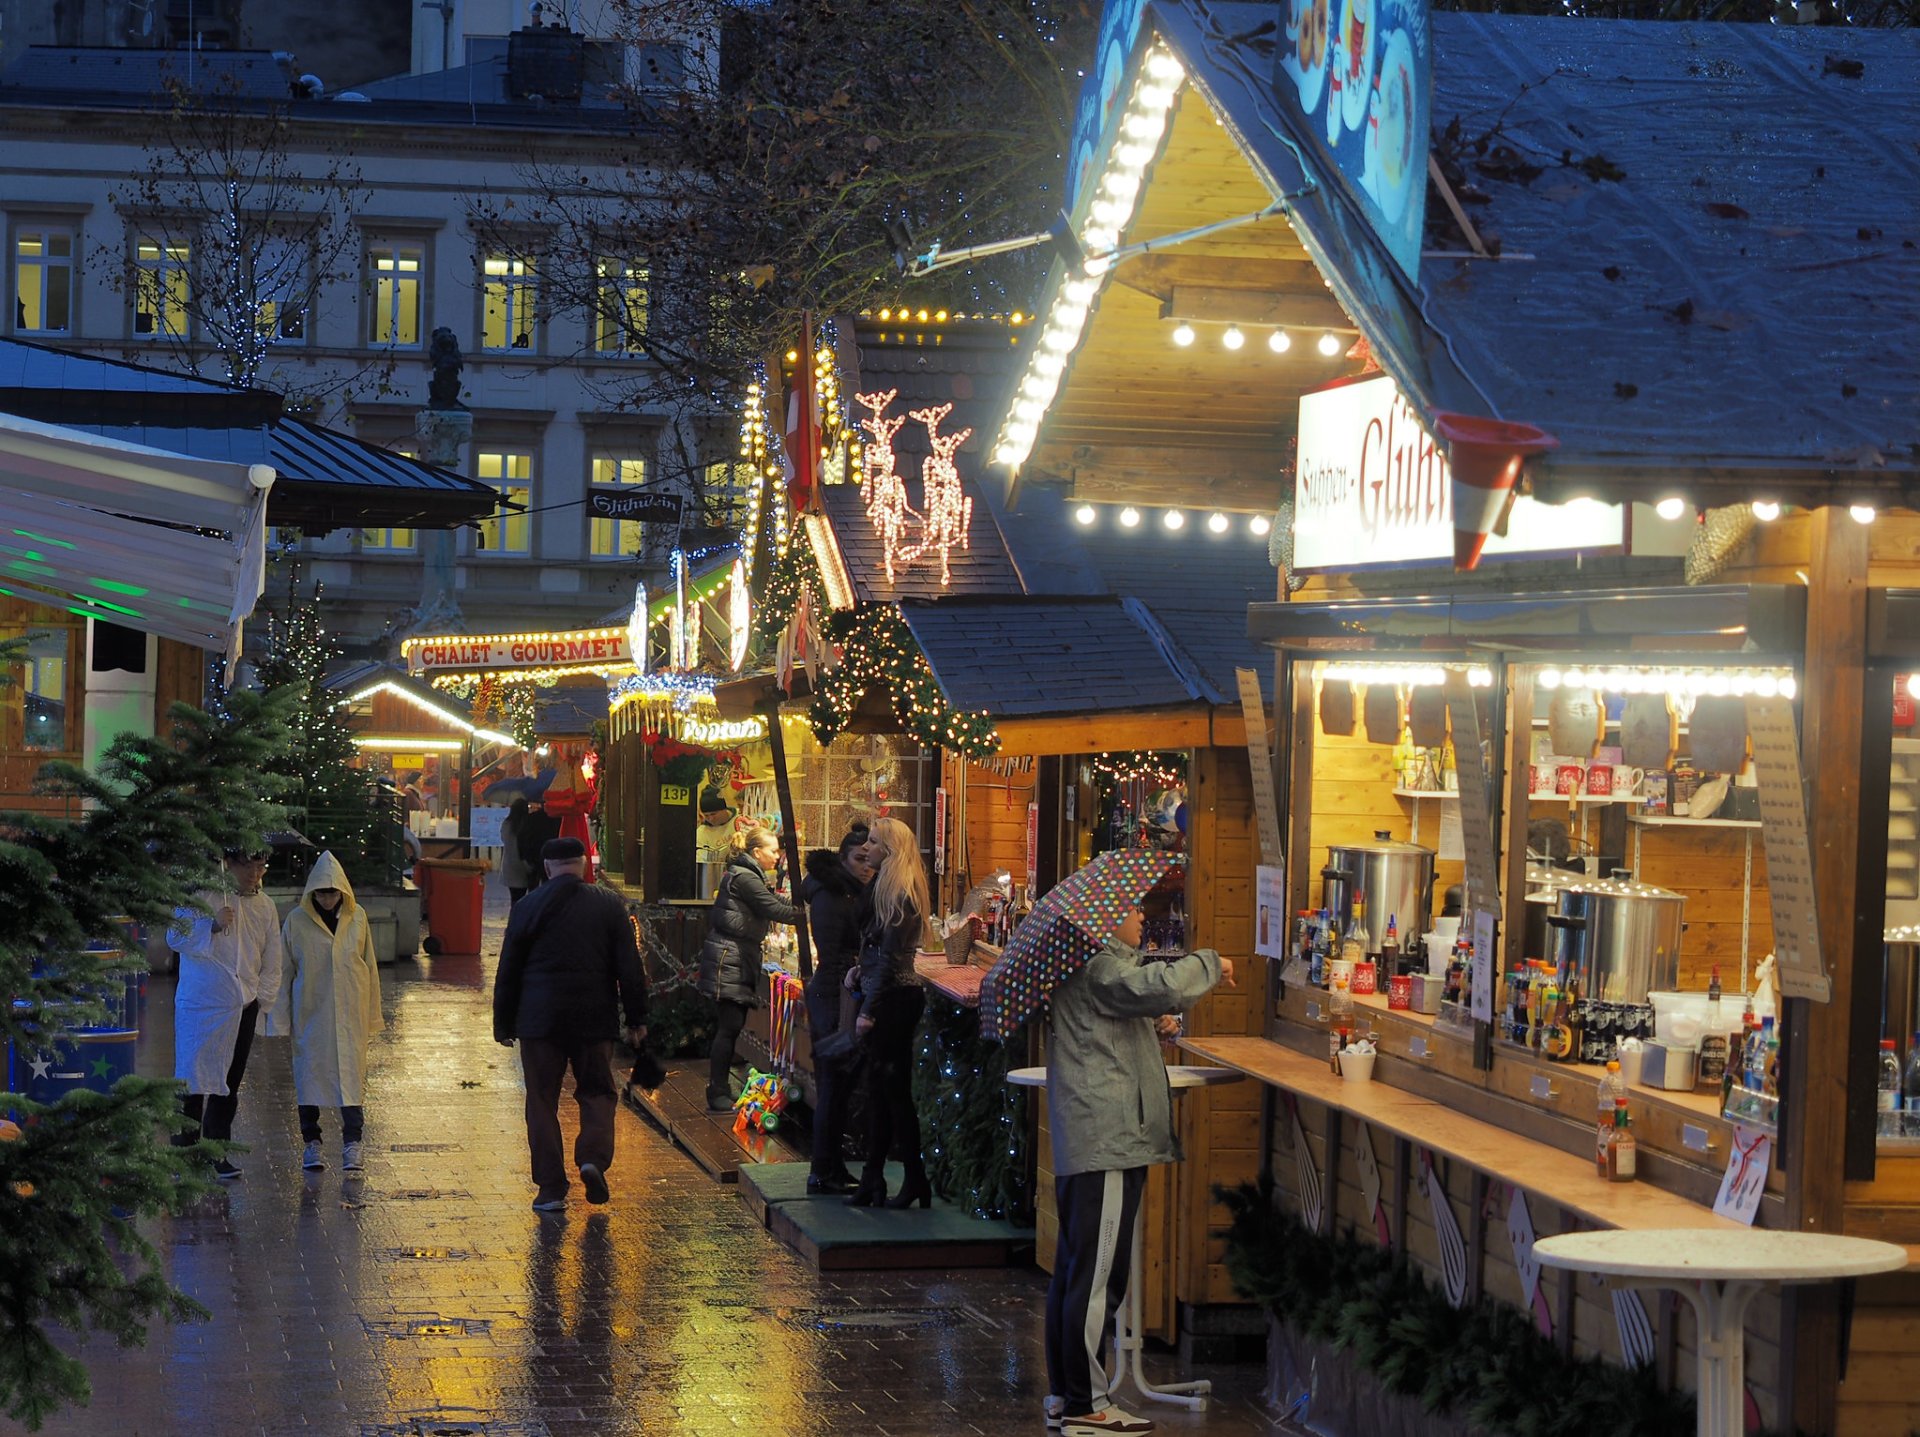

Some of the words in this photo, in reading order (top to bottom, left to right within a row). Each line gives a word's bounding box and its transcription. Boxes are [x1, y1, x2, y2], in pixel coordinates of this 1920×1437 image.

[421, 643, 491, 666] CHALET
[510, 637, 623, 663] GOURMET
[663, 787, 688, 801] 13P
